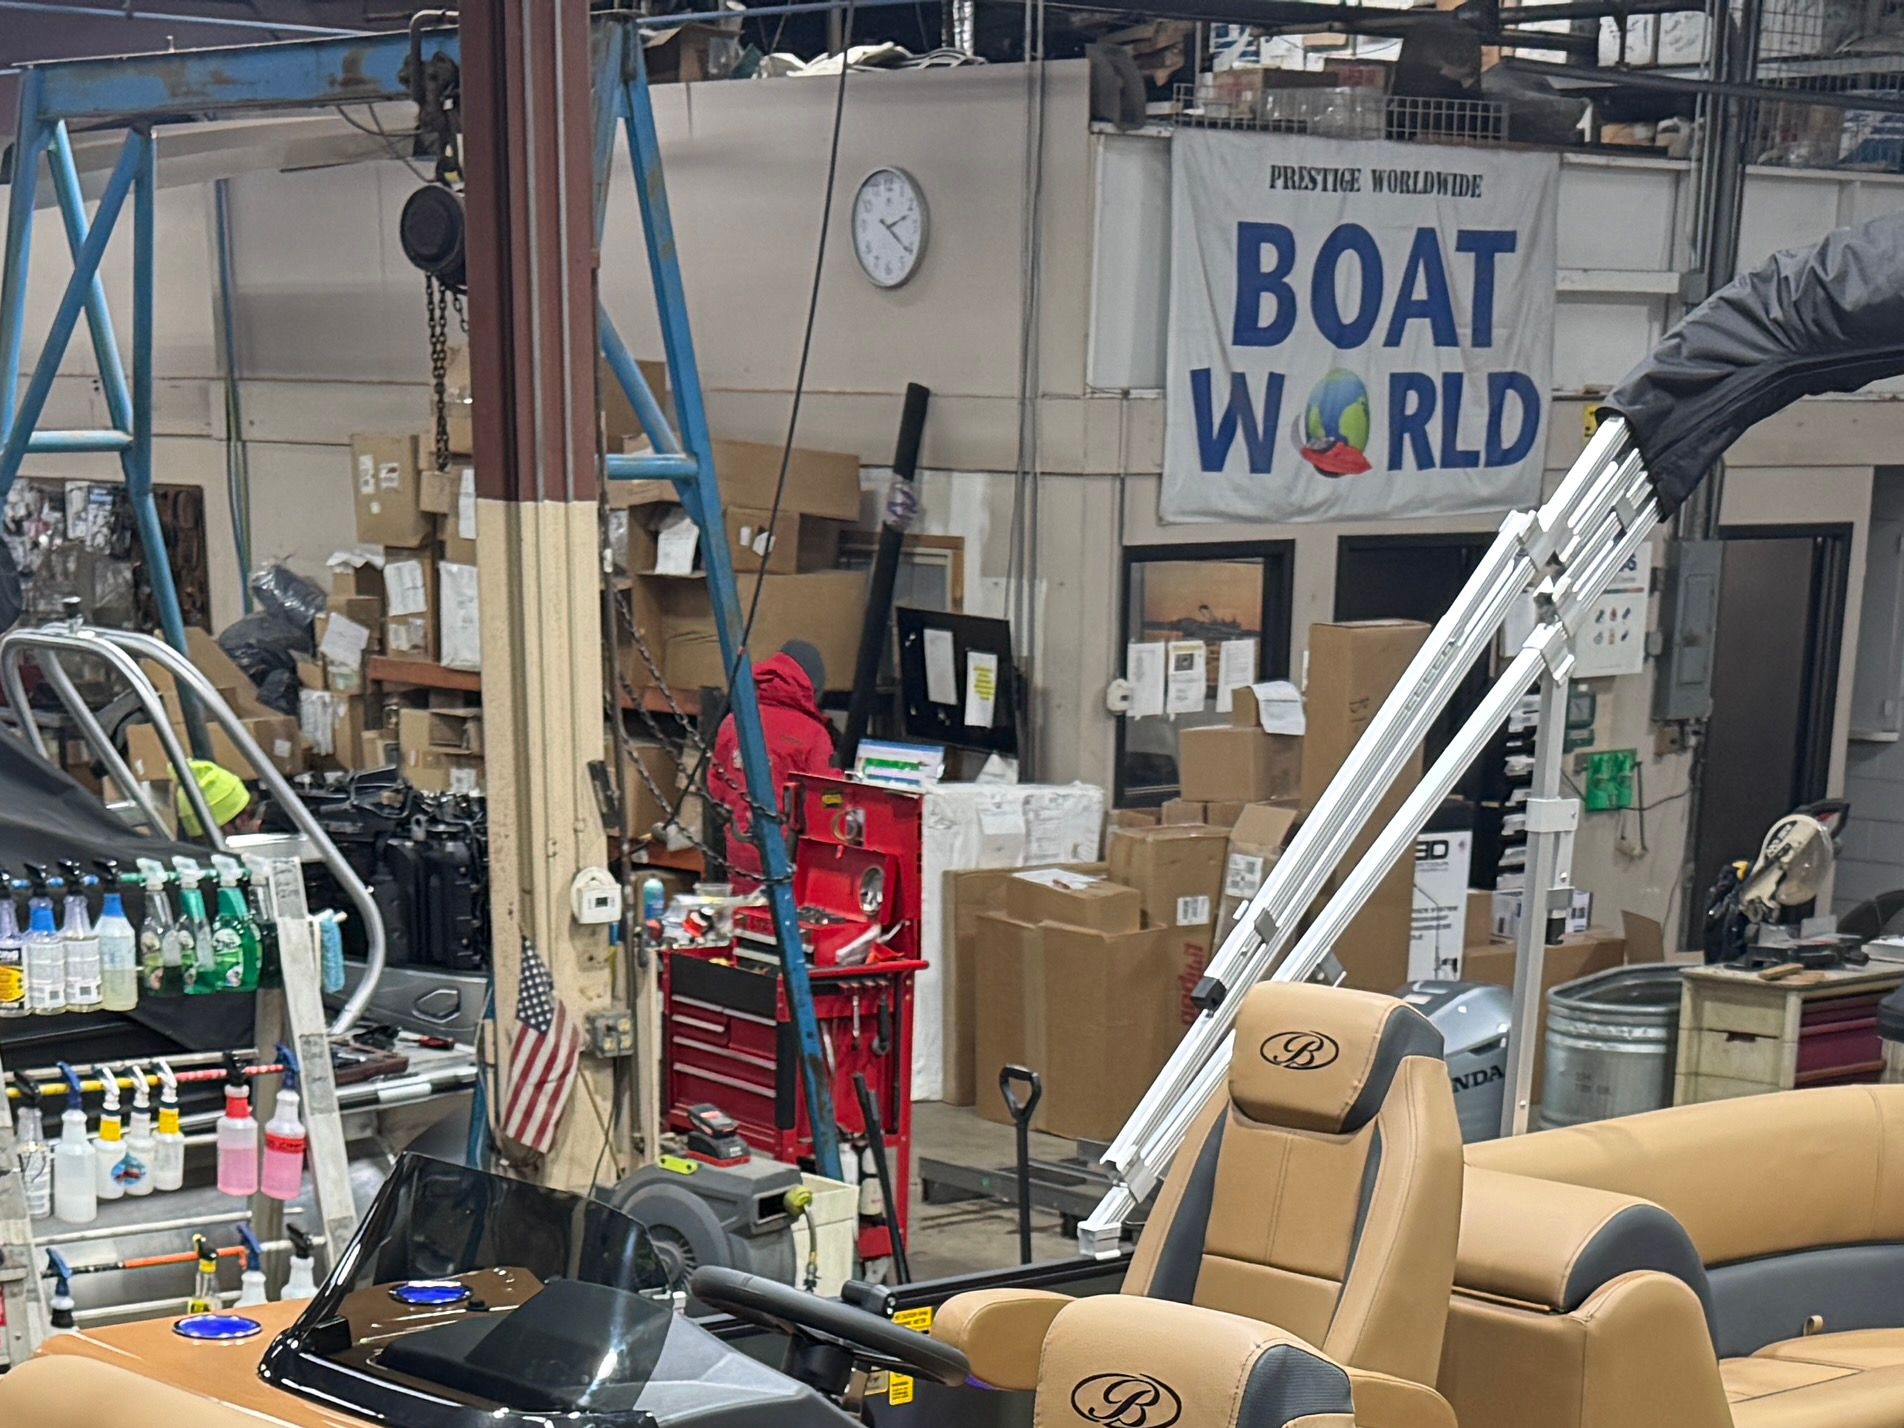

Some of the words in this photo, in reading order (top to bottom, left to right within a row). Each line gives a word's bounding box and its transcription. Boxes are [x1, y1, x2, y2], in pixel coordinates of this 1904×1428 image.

[1269, 164, 1361, 193] PRESTIGE
[1371, 168, 1483, 198] WORLDWIDE
[1231, 220, 1517, 350] BOAT
[1450, 1064, 1505, 1093] NDA
